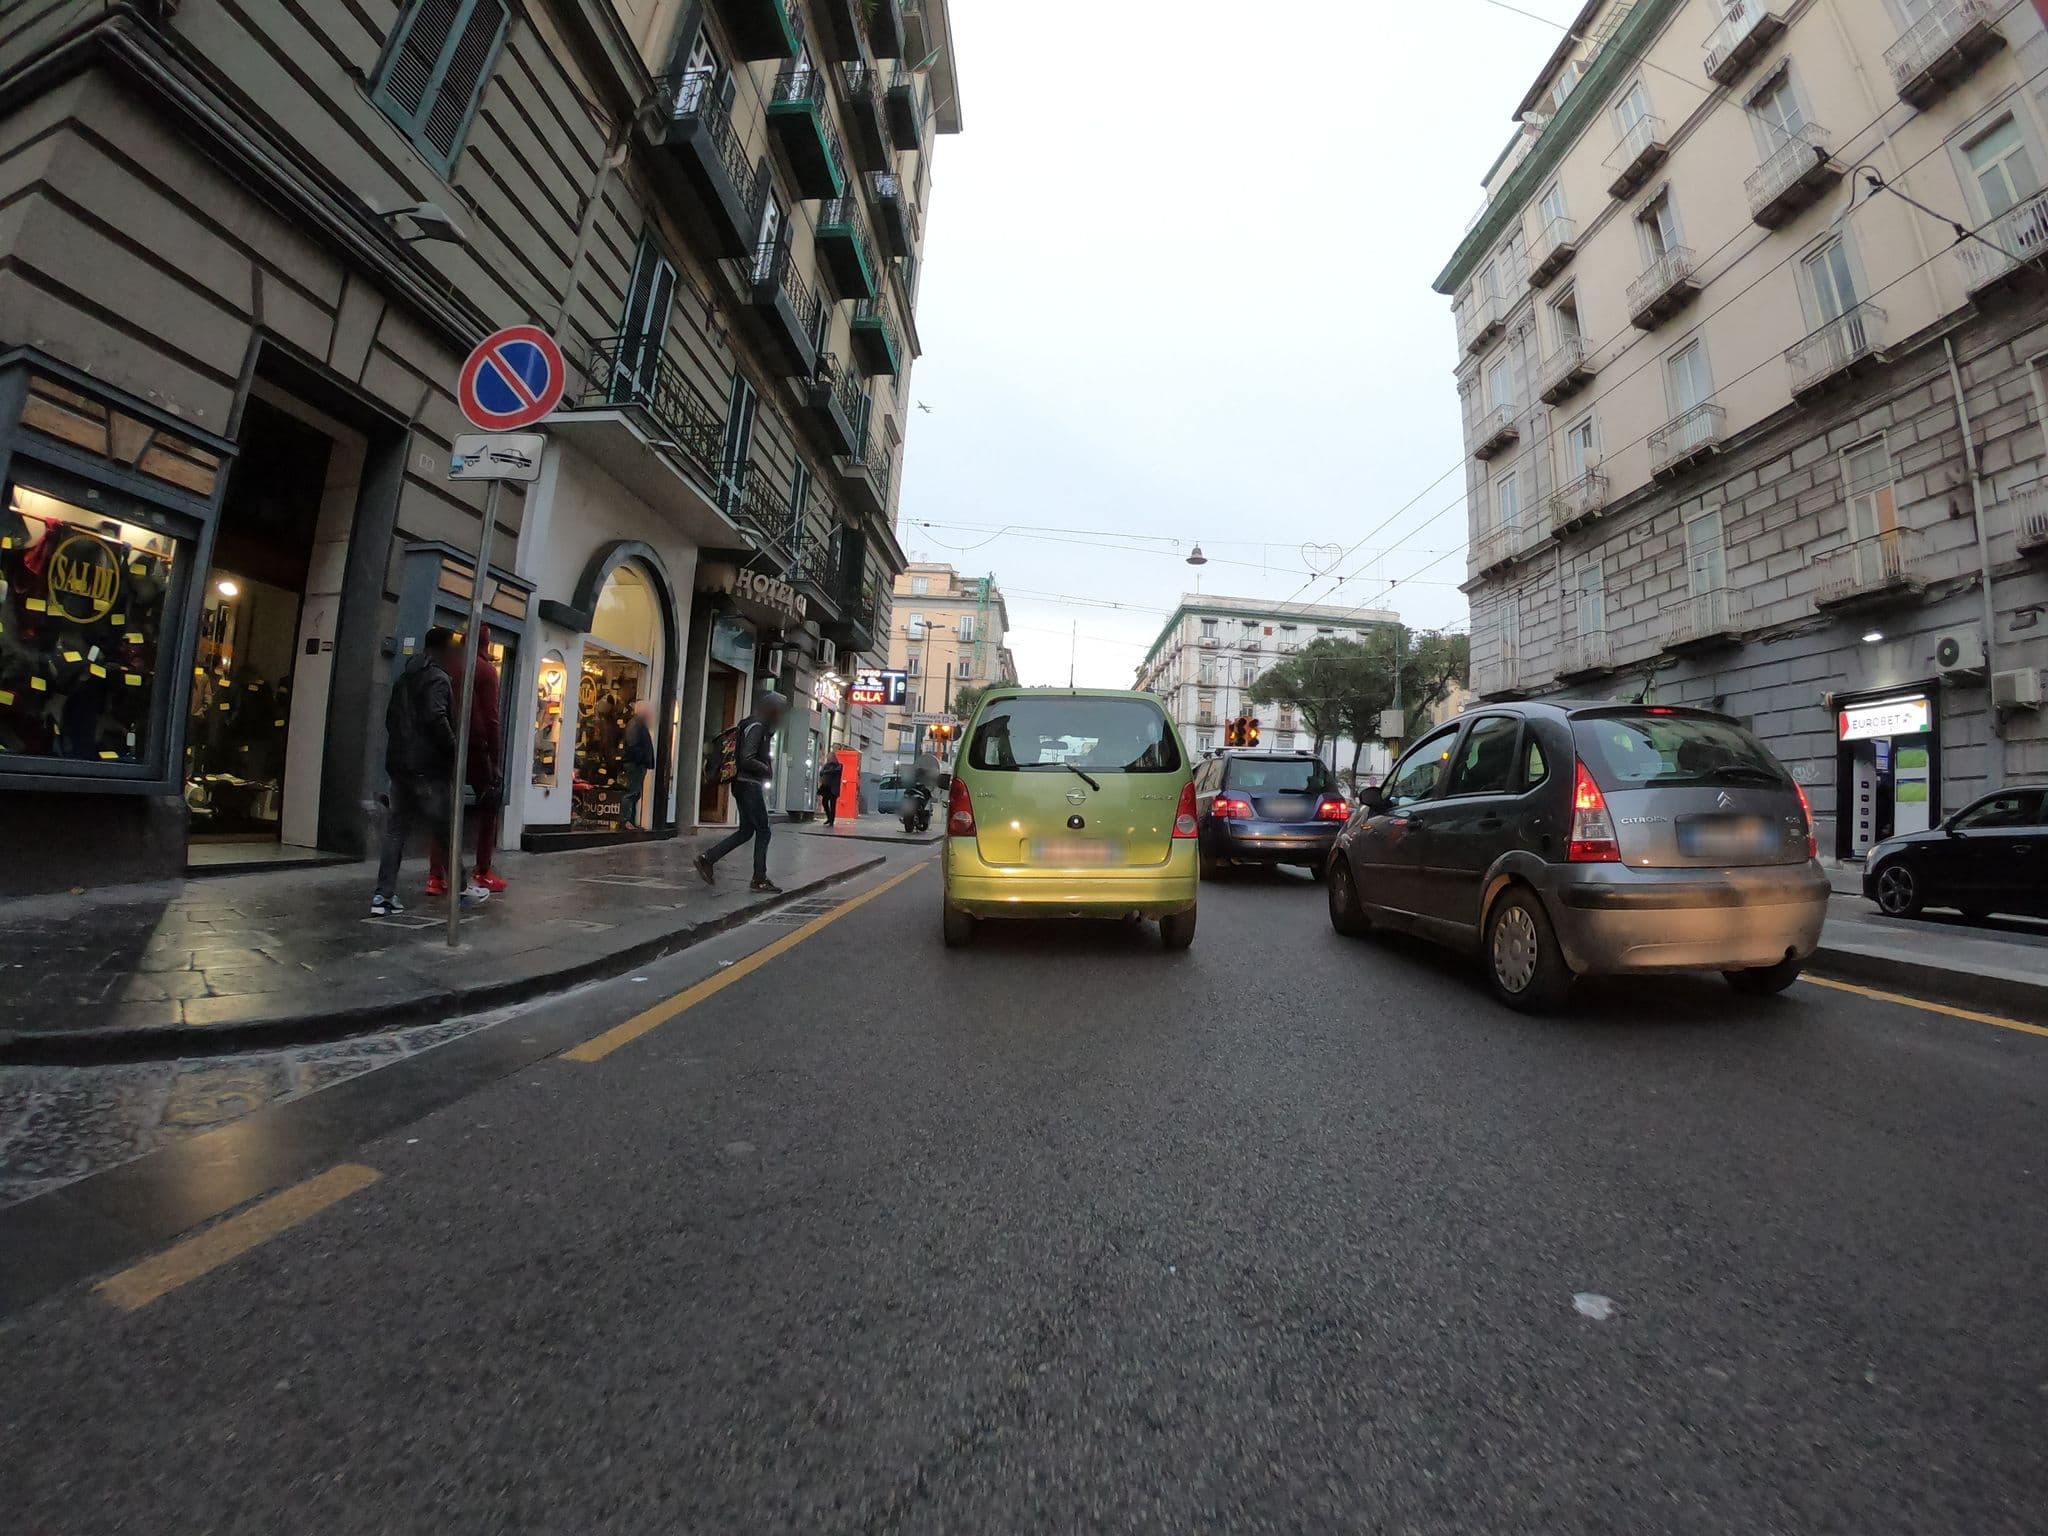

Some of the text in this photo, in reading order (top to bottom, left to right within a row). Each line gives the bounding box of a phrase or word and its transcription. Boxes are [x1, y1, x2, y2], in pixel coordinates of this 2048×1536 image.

[54, 553, 114, 602] SALDI
[736, 568, 795, 607] HOTEL
[1853, 714, 1900, 729] EUROBET
